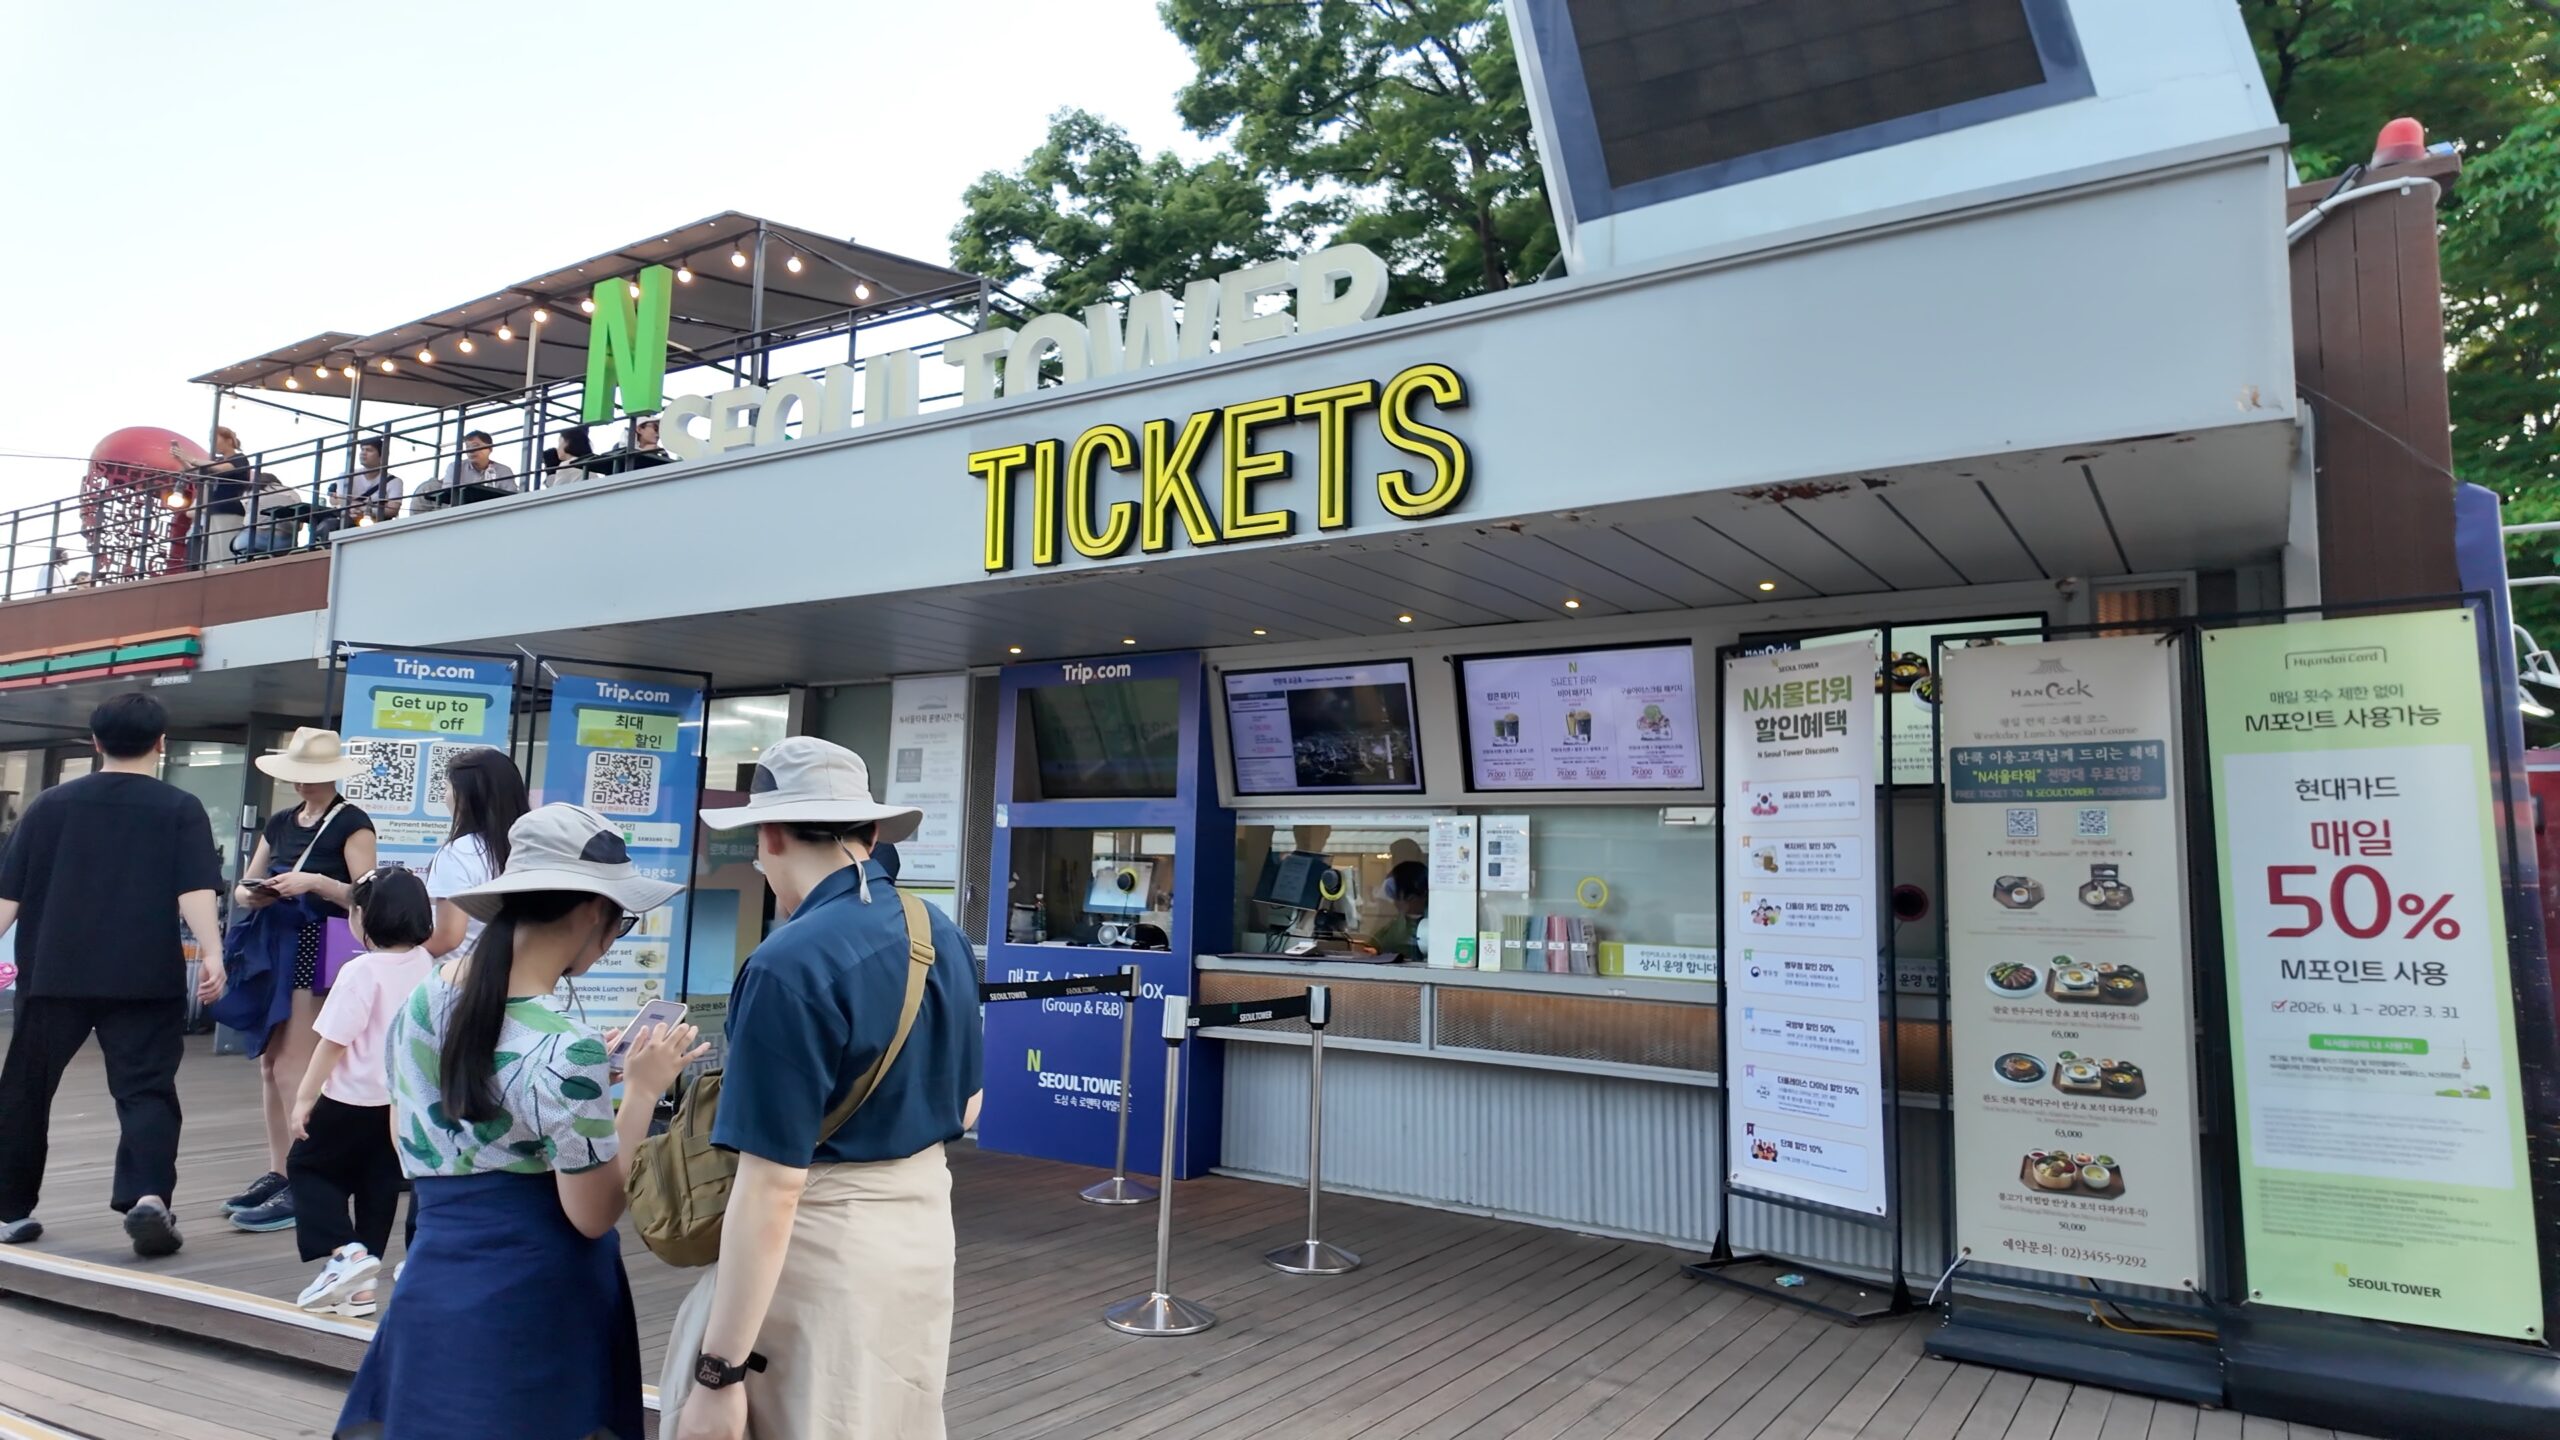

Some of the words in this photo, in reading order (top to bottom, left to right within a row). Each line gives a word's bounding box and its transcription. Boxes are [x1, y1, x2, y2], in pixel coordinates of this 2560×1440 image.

[583, 264, 673, 426] N
[659, 349, 920, 461] SEOUL
[943, 243, 1388, 406] TOWER
[968, 363, 1474, 573] TICKETS
[1568, 661, 1577, 673] N
[2294, 653, 2347, 668] Hyundai
[2348, 652, 2378, 663] Card
[394, 658, 475, 680] Trip.com
[1063, 664, 1131, 684] Trip.com
[1551, 676, 1578, 687] SWEET
[1581, 675, 1597, 685] BAR
[596, 682, 670, 703] Trip.com
[1743, 675, 1853, 712] N서울타워
[2269, 690, 2299, 704] 매일
[2303, 689, 2333, 704] 횟수
[2338, 686, 2368, 701] 제한
[2373, 683, 2404, 699] 없이
[392, 695, 421, 709] Get
[426, 699, 447, 713] up
[452, 700, 469, 712] to
[439, 717, 465, 731] off
[615, 714, 644, 730] 최대
[1755, 709, 1847, 743] 할인혜택
[2050, 714, 2082, 725] 스페셜
[2086, 714, 2109, 723] 코스
[2245, 709, 2337, 732] M포인트
[2344, 704, 2441, 729] 사용가능
[635, 733, 662, 749] 할인
[1974, 730, 2018, 741] Weekday
[2023, 729, 2055, 739] Lunch
[2059, 726, 2096, 739] Special
[2100, 726, 2138, 736] Course
[1764, 750, 1781, 758] Seoul
[1783, 749, 1803, 757] Tower
[1805, 746, 1839, 755] Discounts
[1989, 748, 2074, 765] 이용고객님께
[2080, 747, 2123, 760] 드리는
[2047, 767, 2085, 783] 전망대
[2090, 766, 2142, 782] 무료입장
[2026, 789, 2033, 797] N
[2295, 776, 2400, 802] 현대카드
[389, 821, 420, 829] Payment
[421, 821, 447, 829] Method
[2310, 819, 2393, 857] 매일
[635, 864, 676, 878] kages
[1820, 903, 1833, 911] 할인
[1835, 903, 1850, 911] 20%
[2266, 864, 2461, 940] 50%
[1640, 959, 1660, 971] 상시
[1664, 960, 1683, 973] 운영
[1686, 961, 1717, 974] 합니다
[1804, 962, 1817, 971] 할인
[1819, 963, 1834, 972] 20%
[2281, 959, 2387, 983] M포인트
[2394, 961, 2448, 986] 사용
[1900, 973, 1922, 987] 운영
[1139, 982, 1164, 1000] OX
[1042, 998, 1082, 1016] (Group
[1083, 1002, 1093, 1013] &
[1096, 1001, 1124, 1019] F&B)
[2290, 1001, 2328, 1014] 2026.
[2352, 1003, 2360, 1015] 1
[2379, 1004, 2418, 1017] 2027.
[2442, 1006, 2460, 1019] 31
[1806, 1023, 1819, 1032] 할인
[1820, 1024, 1835, 1033] 50%
[2051, 1030, 2079, 1040] 65,000
[1027, 1048, 1041, 1072] N
[1830, 1084, 1843, 1093] 할인
[1844, 1086, 1859, 1095] 50%
[1054, 1094, 1069, 1106] 도심
[1070, 1096, 1077, 1107] 속
[2055, 1128, 2083, 1138] 63,000
[1795, 1142, 1807, 1151] 할인
[1999, 1192, 2023, 1203] 불고기
[2058, 1221, 2087, 1232] 50,000
[2002, 1238, 2057, 1256] 예약문의:
[2061, 1246, 2147, 1268] 02)3455-9292
[2348, 1277, 2442, 1299] SEOULTOWER
